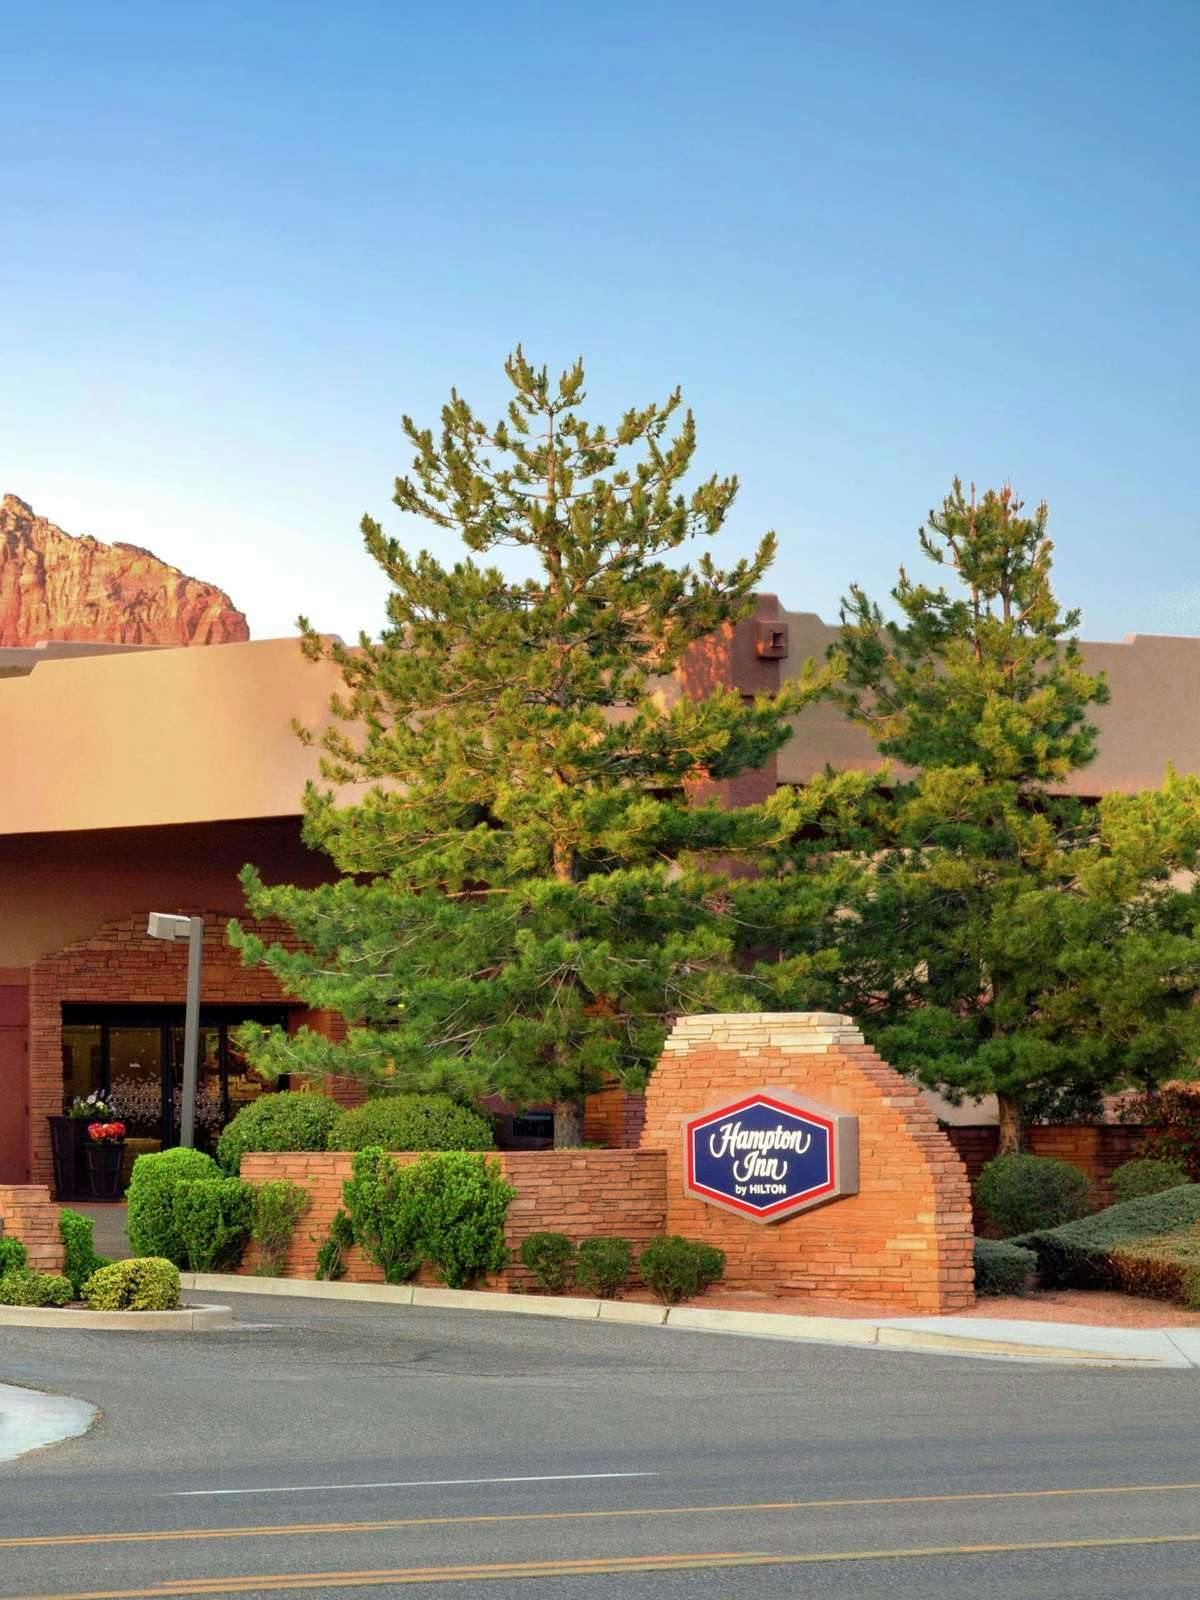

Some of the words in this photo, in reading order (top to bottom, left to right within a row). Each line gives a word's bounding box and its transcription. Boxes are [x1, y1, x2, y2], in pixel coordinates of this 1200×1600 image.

[710, 1122, 811, 1158] Hampton
[733, 1150, 788, 1182] Inn
[735, 1184, 747, 1196] by
[749, 1184, 787, 1194] HILTON
